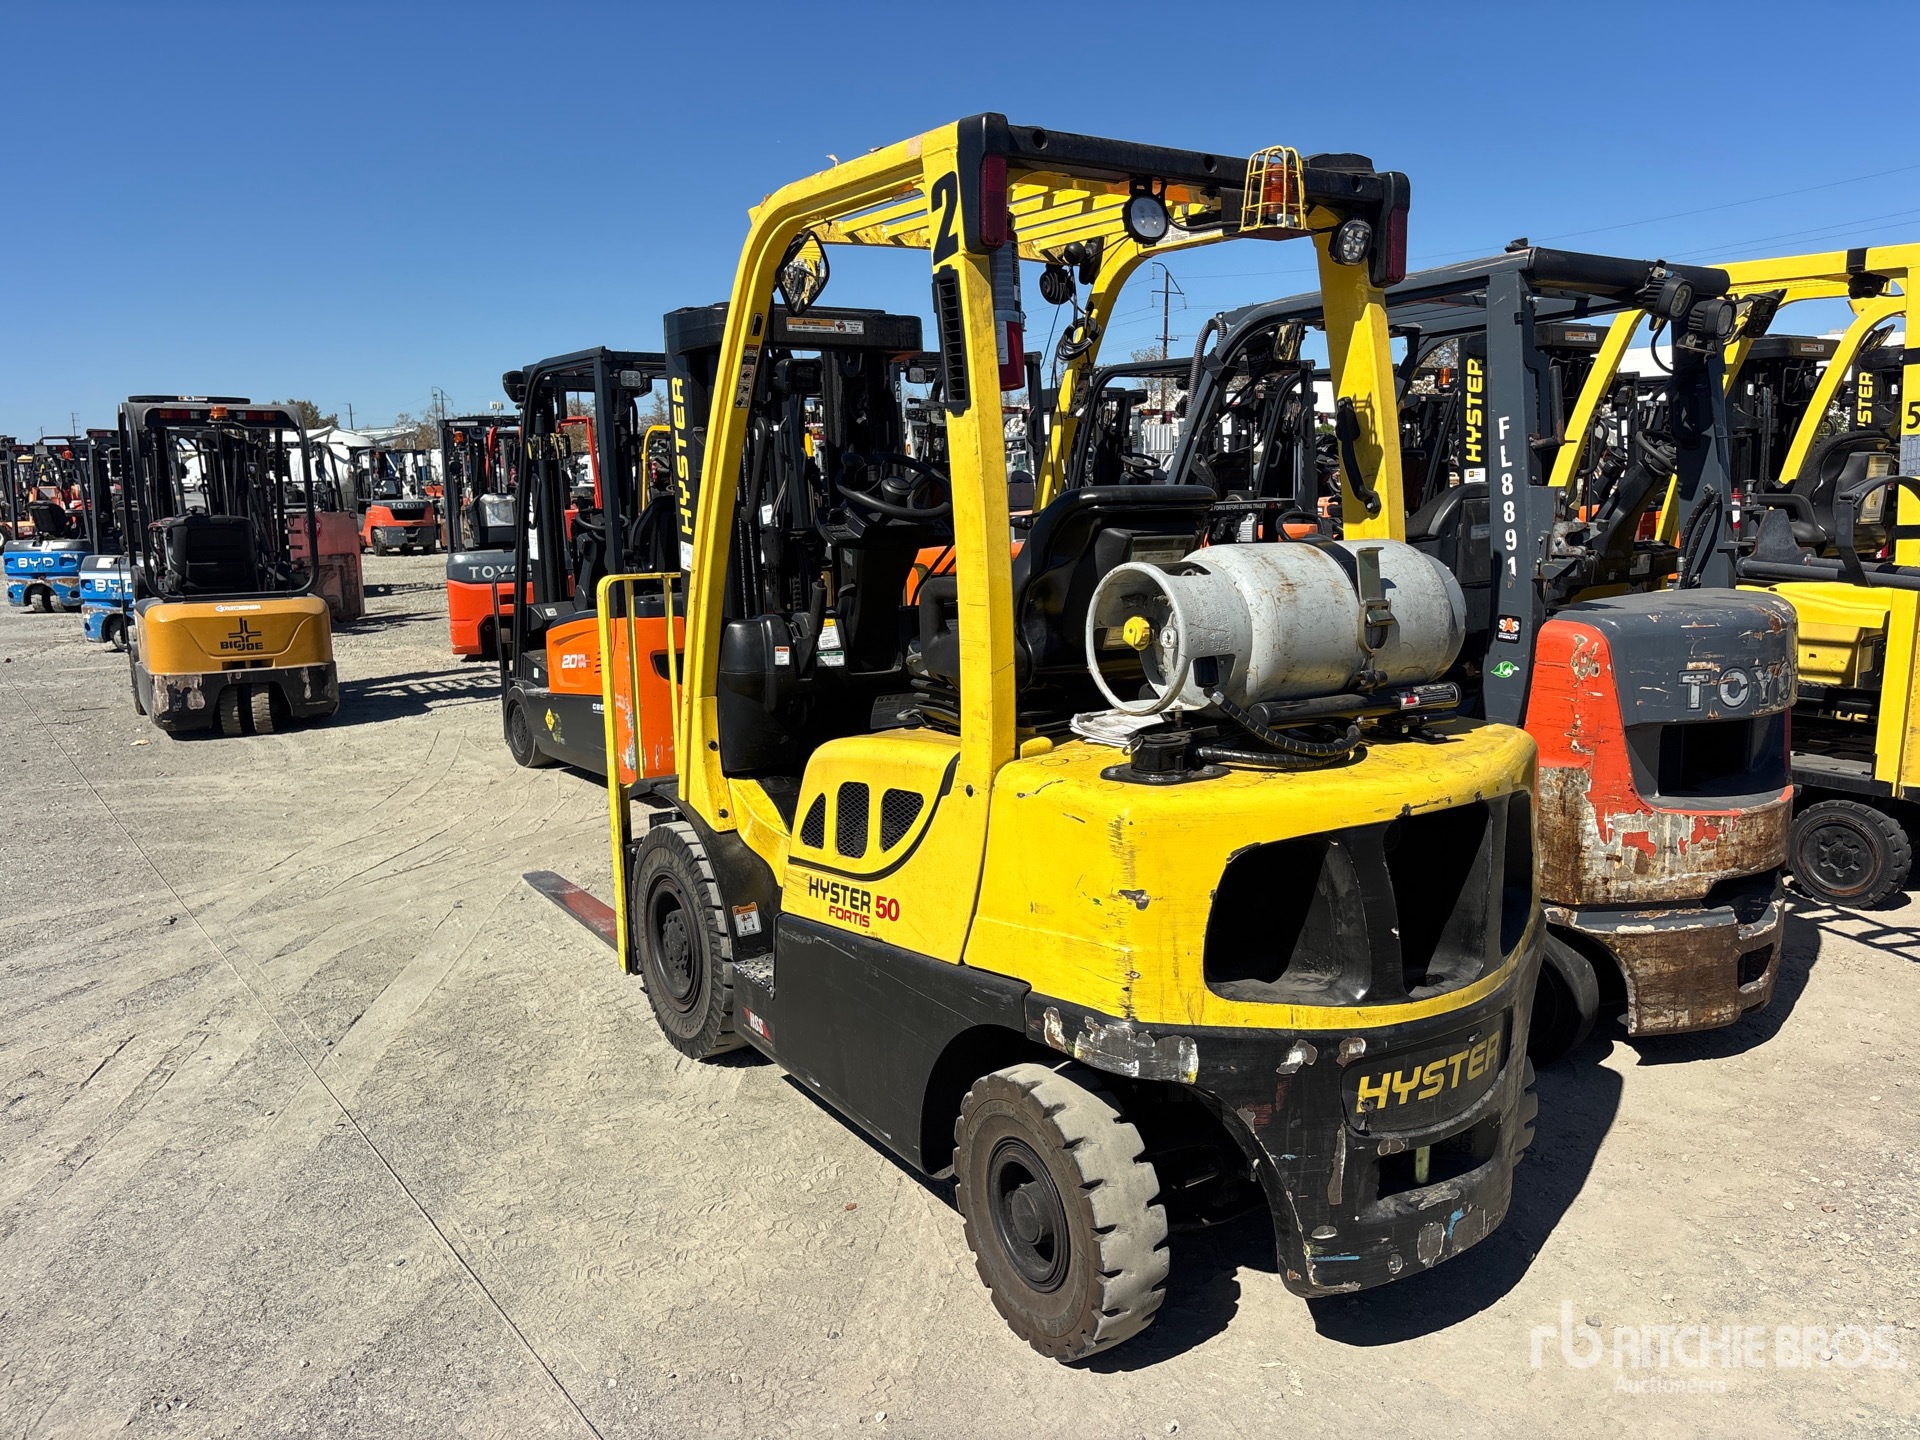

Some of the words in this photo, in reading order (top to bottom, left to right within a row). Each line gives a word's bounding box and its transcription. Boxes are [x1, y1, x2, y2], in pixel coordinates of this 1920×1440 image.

[931, 171, 959, 266] 2
[1466, 358, 1483, 462] HYSTER
[1857, 371, 1873, 427] STER
[671, 377, 693, 536] HYSTER
[17, 557, 55, 568] BYD
[1499, 618, 1520, 633] SAS
[809, 876, 871, 913] HYSTER
[875, 895, 900, 921] 50
[829, 905, 870, 928] FORTIS
[750, 1011, 764, 1034] HSS
[1356, 1030, 1500, 1113] HYSTER
